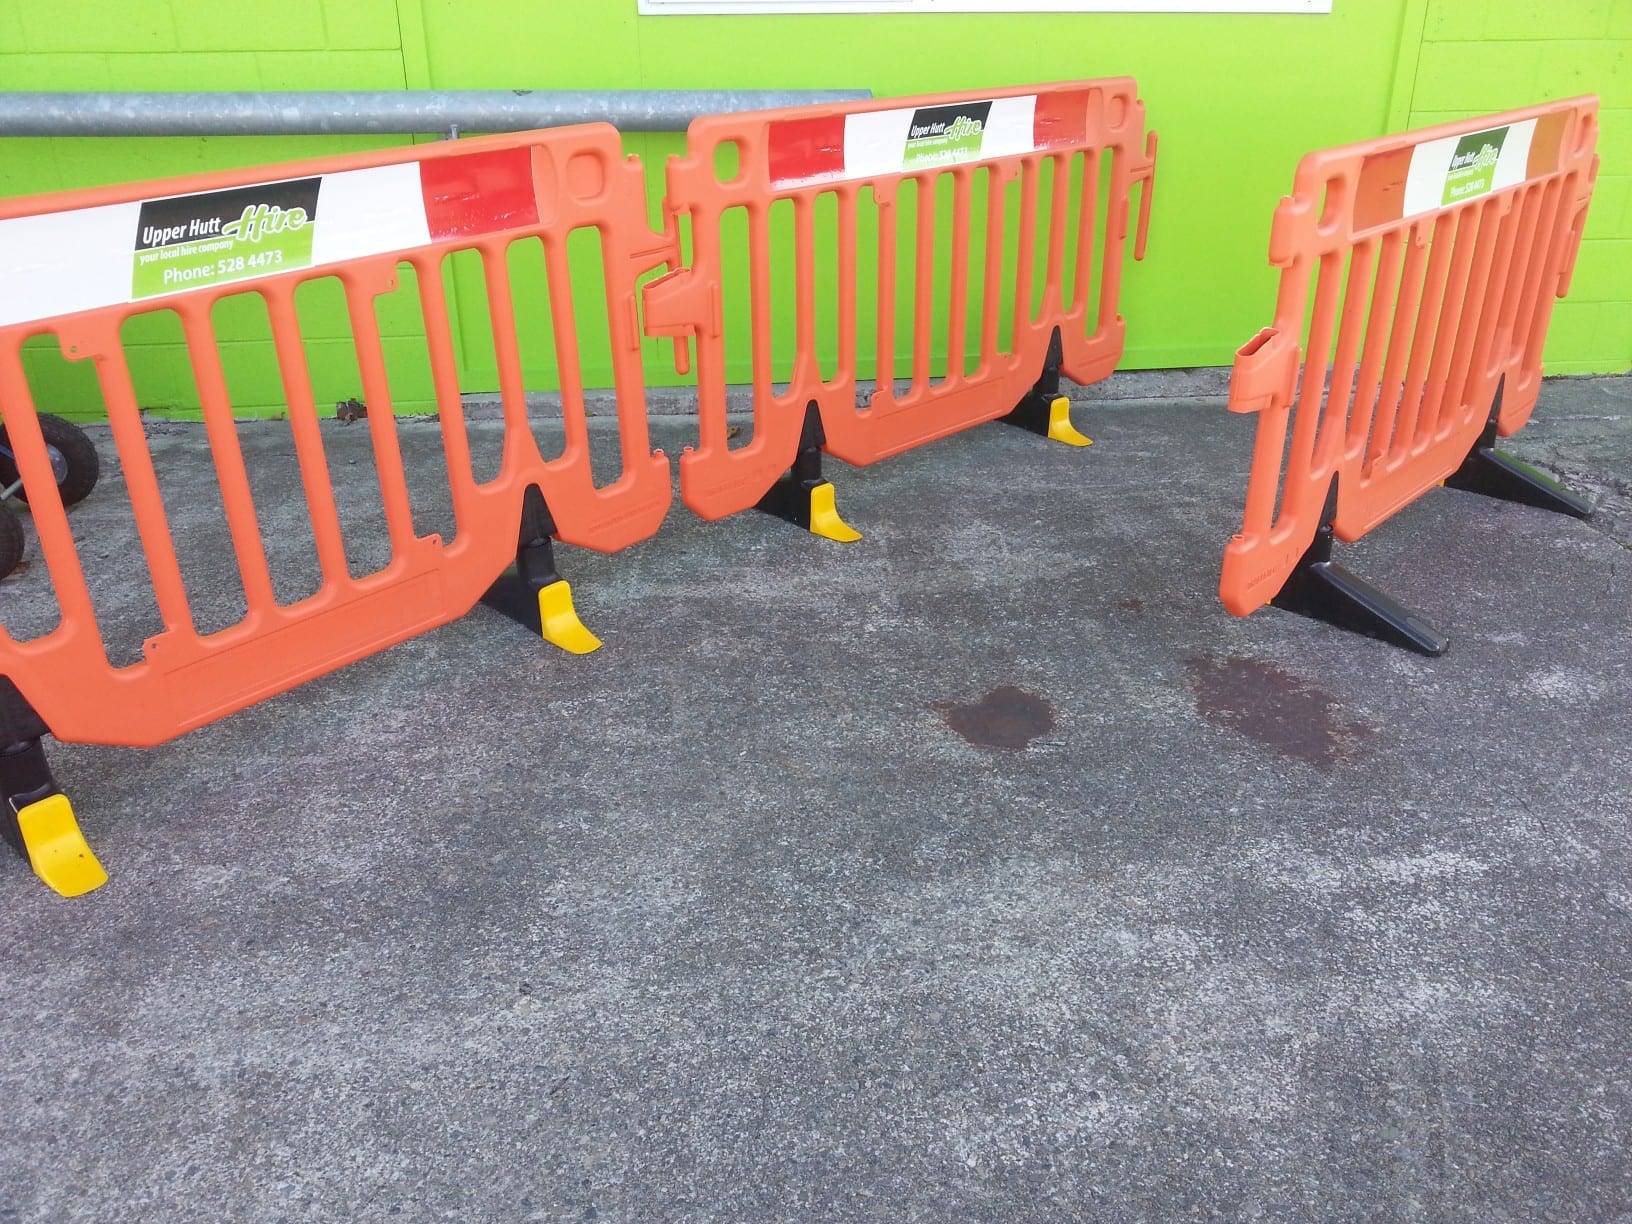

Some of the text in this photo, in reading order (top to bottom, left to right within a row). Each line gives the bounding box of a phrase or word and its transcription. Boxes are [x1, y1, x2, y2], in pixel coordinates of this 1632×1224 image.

[911, 115, 982, 141] Upper Hutt Hire
[143, 204, 307, 248] Upper Hutt Hire
[140, 240, 234, 265] your local hire company
[163, 250, 283, 284] Phone: 528 4473
